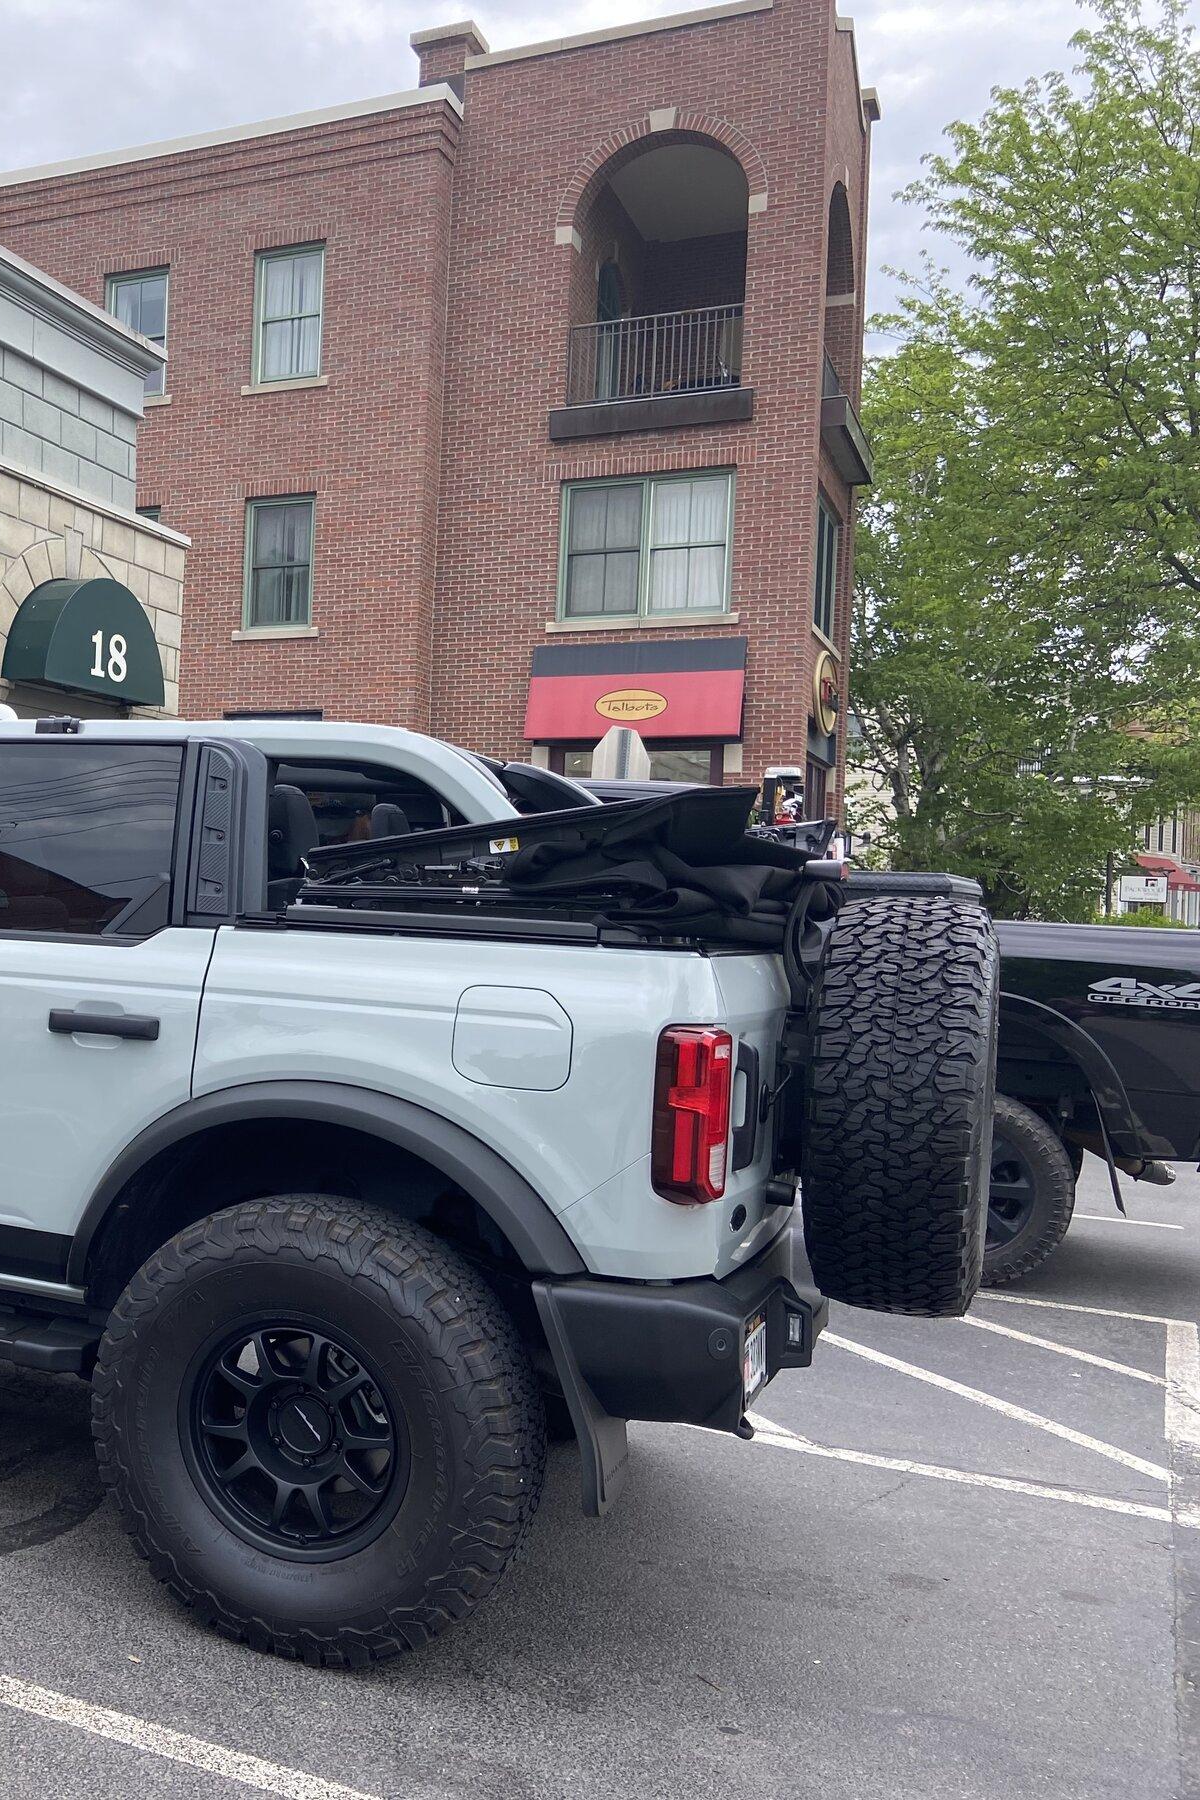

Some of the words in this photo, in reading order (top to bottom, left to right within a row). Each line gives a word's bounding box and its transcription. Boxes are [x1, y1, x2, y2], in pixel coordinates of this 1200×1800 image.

[90, 629, 127, 683] 18
[601, 699, 662, 711] Talbots
[1090, 994, 1139, 1004] OFF
[1146, 997, 1200, 1009] ROA
